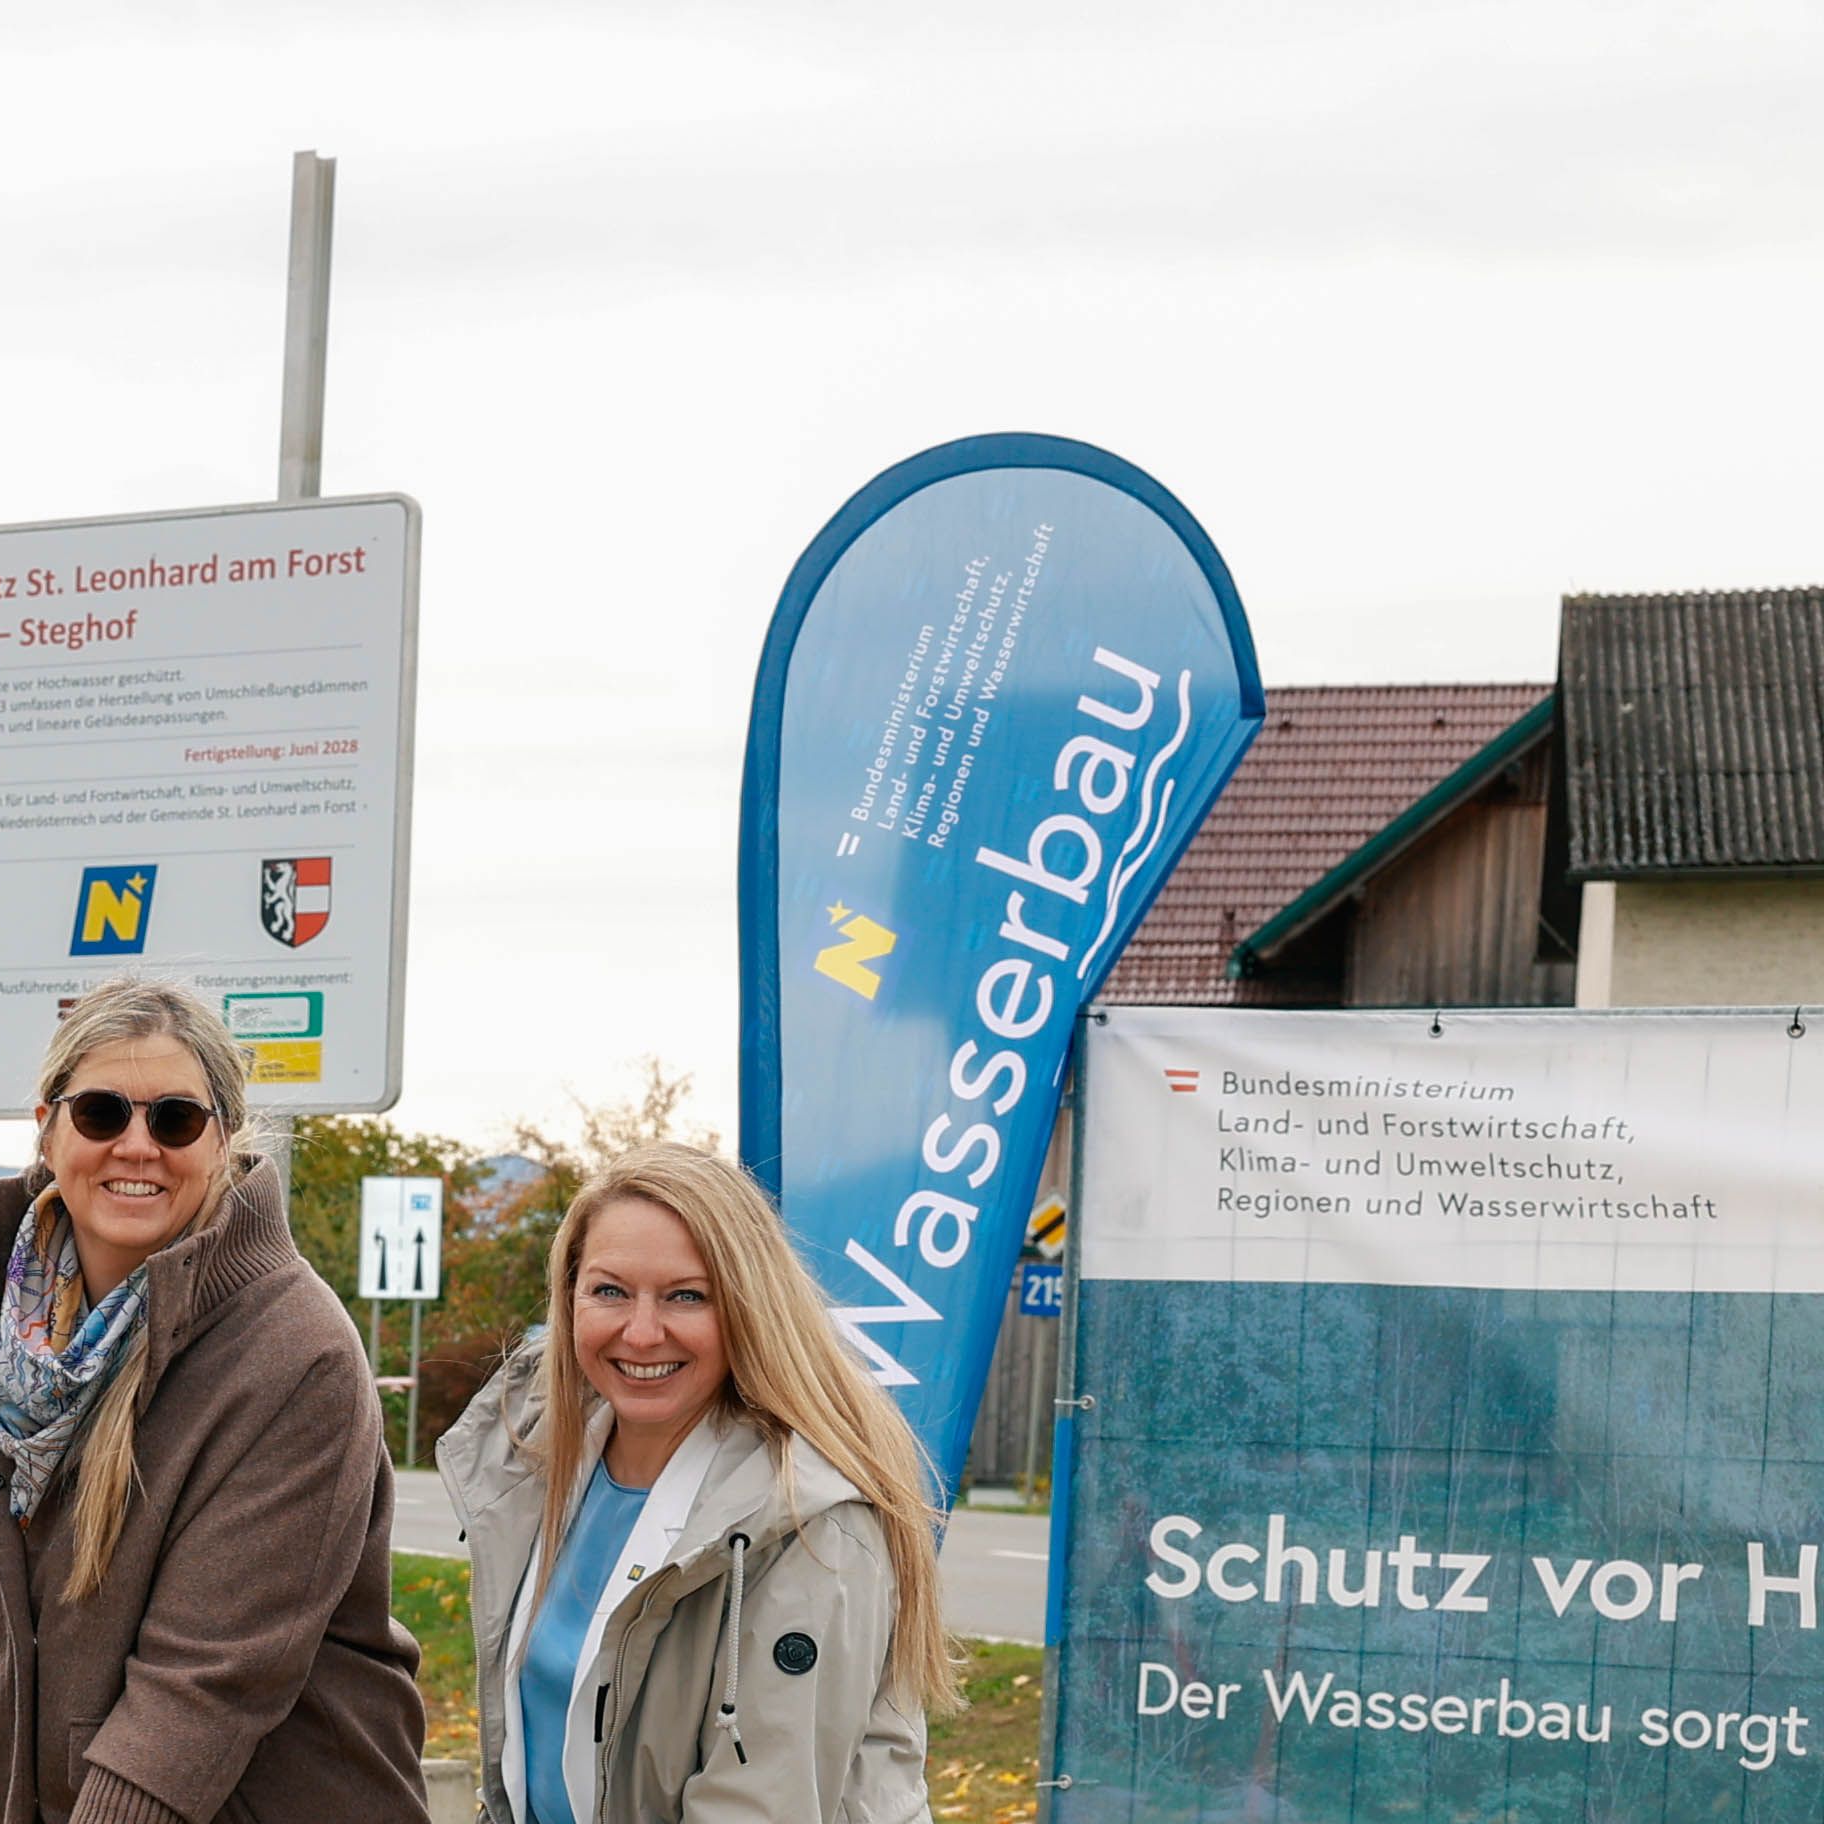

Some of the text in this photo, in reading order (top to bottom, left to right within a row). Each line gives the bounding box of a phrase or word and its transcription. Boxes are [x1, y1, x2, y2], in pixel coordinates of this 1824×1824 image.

[26, 569, 63, 596] St.
[76, 554, 218, 593] Leonhard
[229, 558, 275, 582] am
[289, 547, 365, 577] Forst
[20, 609, 137, 650] Steghof
[10, 697, 71, 712] umfassen
[75, 696, 95, 709] die
[98, 691, 173, 706] Herstellung
[177, 691, 201, 702] von
[205, 681, 368, 701] Umschließungsdämmen
[13, 680, 33, 692] vor
[37, 675, 115, 690] Hochwasser
[118, 670, 184, 688] geschützt.
[877, 553, 991, 831] Land- und Forstwirtschaft,
[927, 523, 1055, 848] Regionen und Wasserwirtschaft
[8, 718, 33, 733] und
[37, 718, 81, 731] lineare
[84, 710, 227, 728] Geländeanpassungen.
[902, 570, 1014, 840] Klima- und Umweltschutz,
[850, 624, 935, 822] Bundesministerium
[185, 745, 285, 764] Fertigstellung:
[289, 741, 318, 756] Juni
[5, 793, 23, 808] für
[26, 792, 59, 806] Land-
[62, 790, 87, 804] und
[90, 785, 185, 802] Forstwirtschaft,
[190, 784, 228, 797] Klima-
[232, 781, 257, 796] und
[260, 778, 356, 794] Umweltschutz,
[99, 811, 123, 824] und
[126, 810, 147, 823] der
[150, 807, 214, 822] Gemeinde
[217, 806, 232, 819] St.
[237, 802, 298, 818] Leonhard
[301, 804, 321, 815] am
[324, 800, 356, 814] Forst
[195, 971, 353, 988] Förderungsmanagement:
[830, 646, 1160, 1385] Wasserbau
[1222, 1071, 1514, 1102] Bundesministerium
[1218, 1109, 1636, 1144] Land- und Forstwirtschaft,
[1219, 1148, 1624, 1184] Klima- und Umweltschutz,
[1218, 1187, 1717, 1220] Regionen und Wasserwirtschaft
[1145, 1513, 1492, 1613] Schutz
[1532, 1556, 1704, 1622] vor
[1137, 1661, 1809, 1771] Der Wasserbau sorgt
